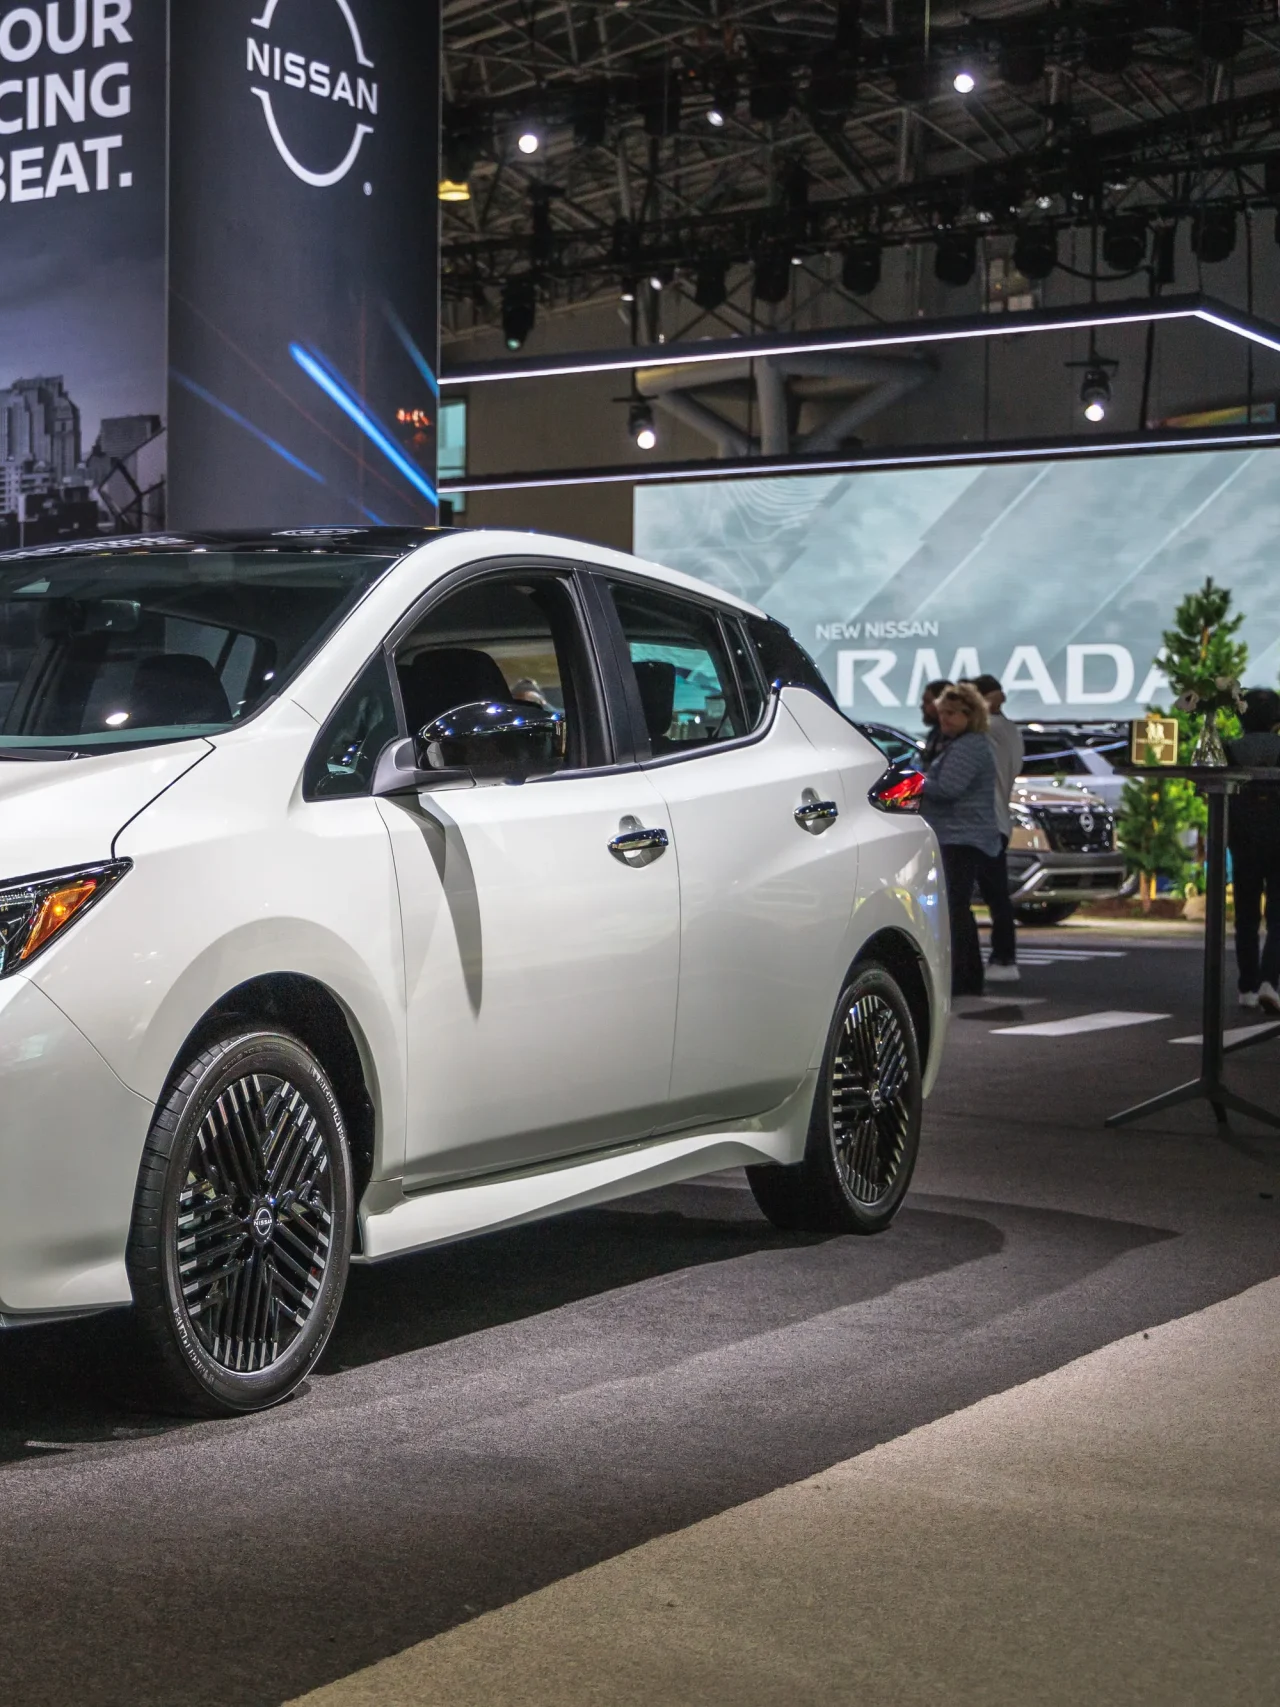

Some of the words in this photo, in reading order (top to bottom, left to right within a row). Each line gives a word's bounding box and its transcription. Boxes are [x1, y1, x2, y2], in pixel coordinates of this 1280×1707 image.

[246, 36, 378, 115] NISSAN
[815, 622, 862, 641] NEW
[865, 620, 939, 639] NISSAN
[834, 643, 1175, 709] RMADA
[253, 1218, 273, 1227] NISSAN
